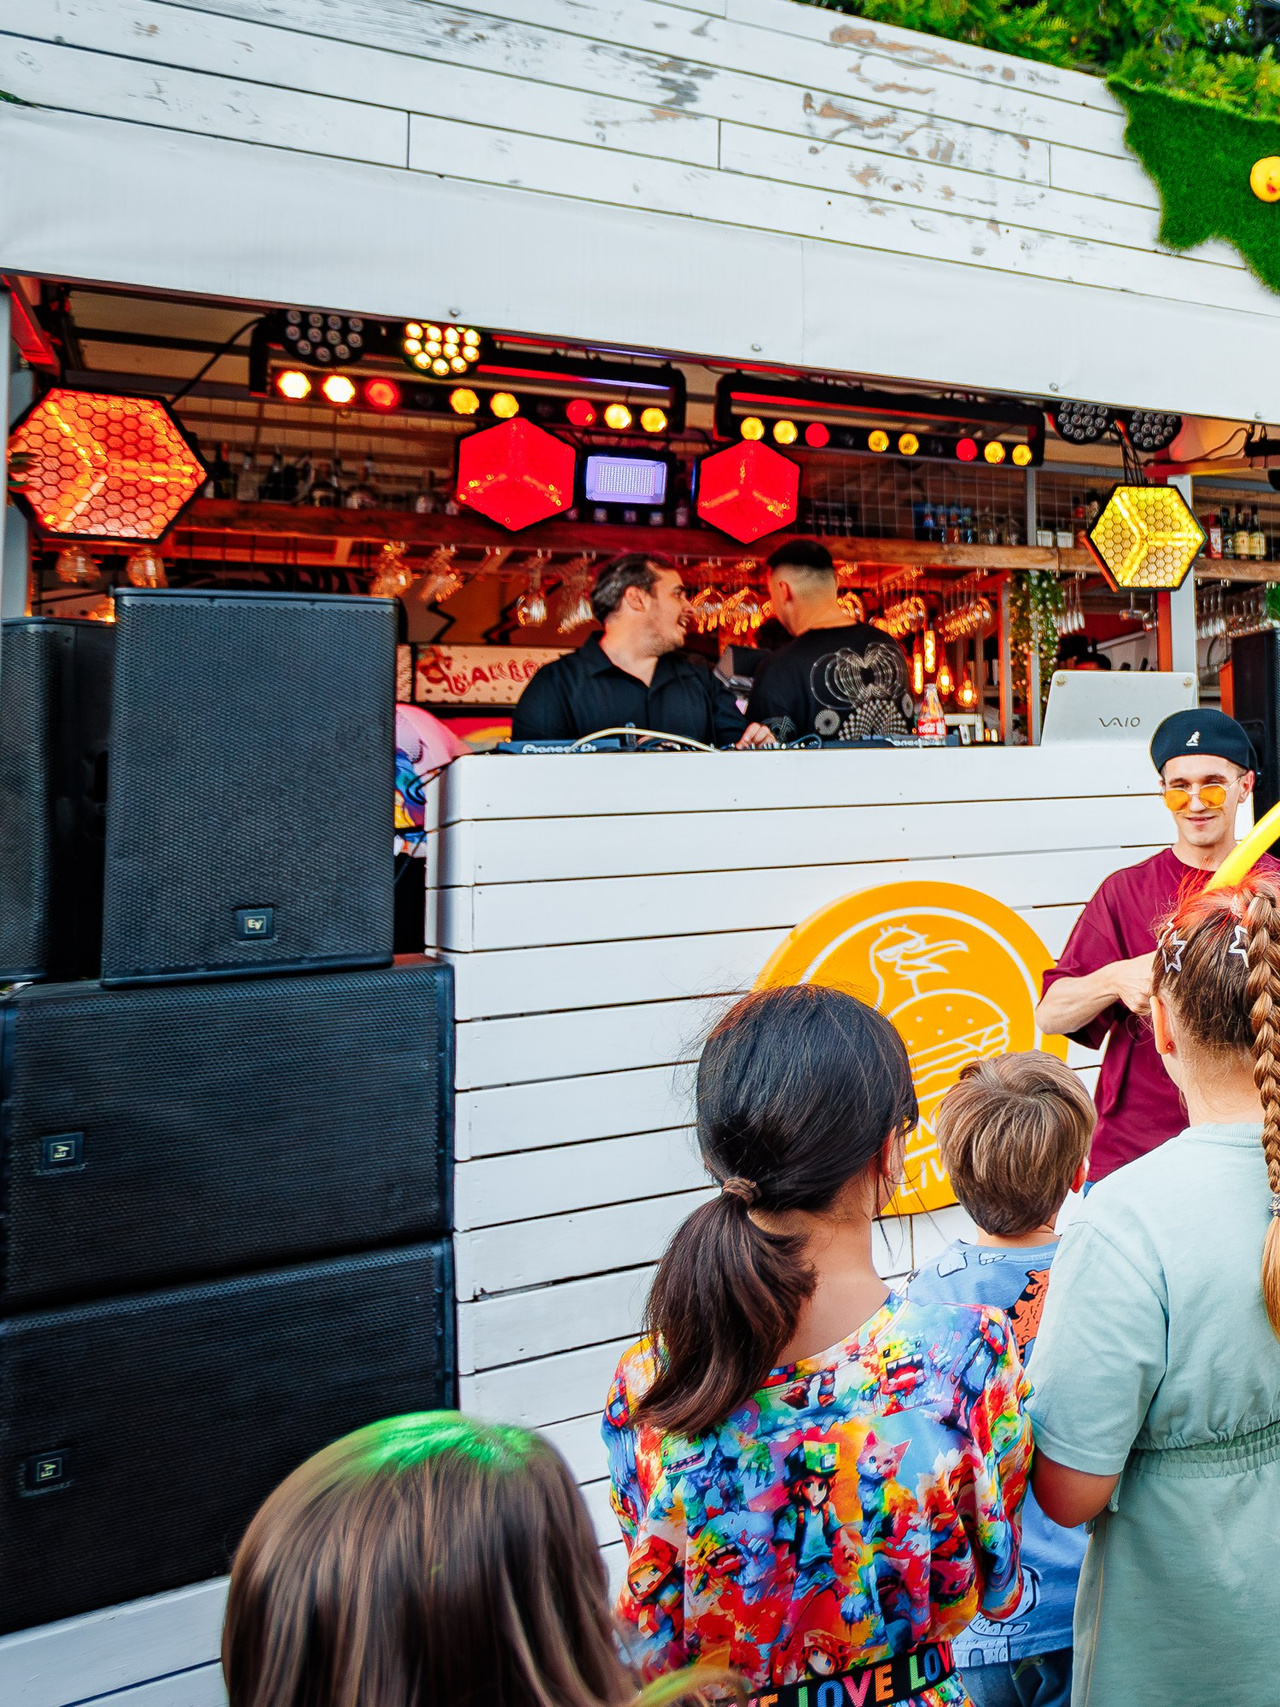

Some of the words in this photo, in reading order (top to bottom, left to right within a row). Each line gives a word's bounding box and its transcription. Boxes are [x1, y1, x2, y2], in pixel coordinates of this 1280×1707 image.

[1098, 716, 1141, 728] VAIO
[900, 1158, 948, 1197] LIV
[798, 1664, 893, 1707] LOVE
[909, 1641, 955, 1691] LOV
